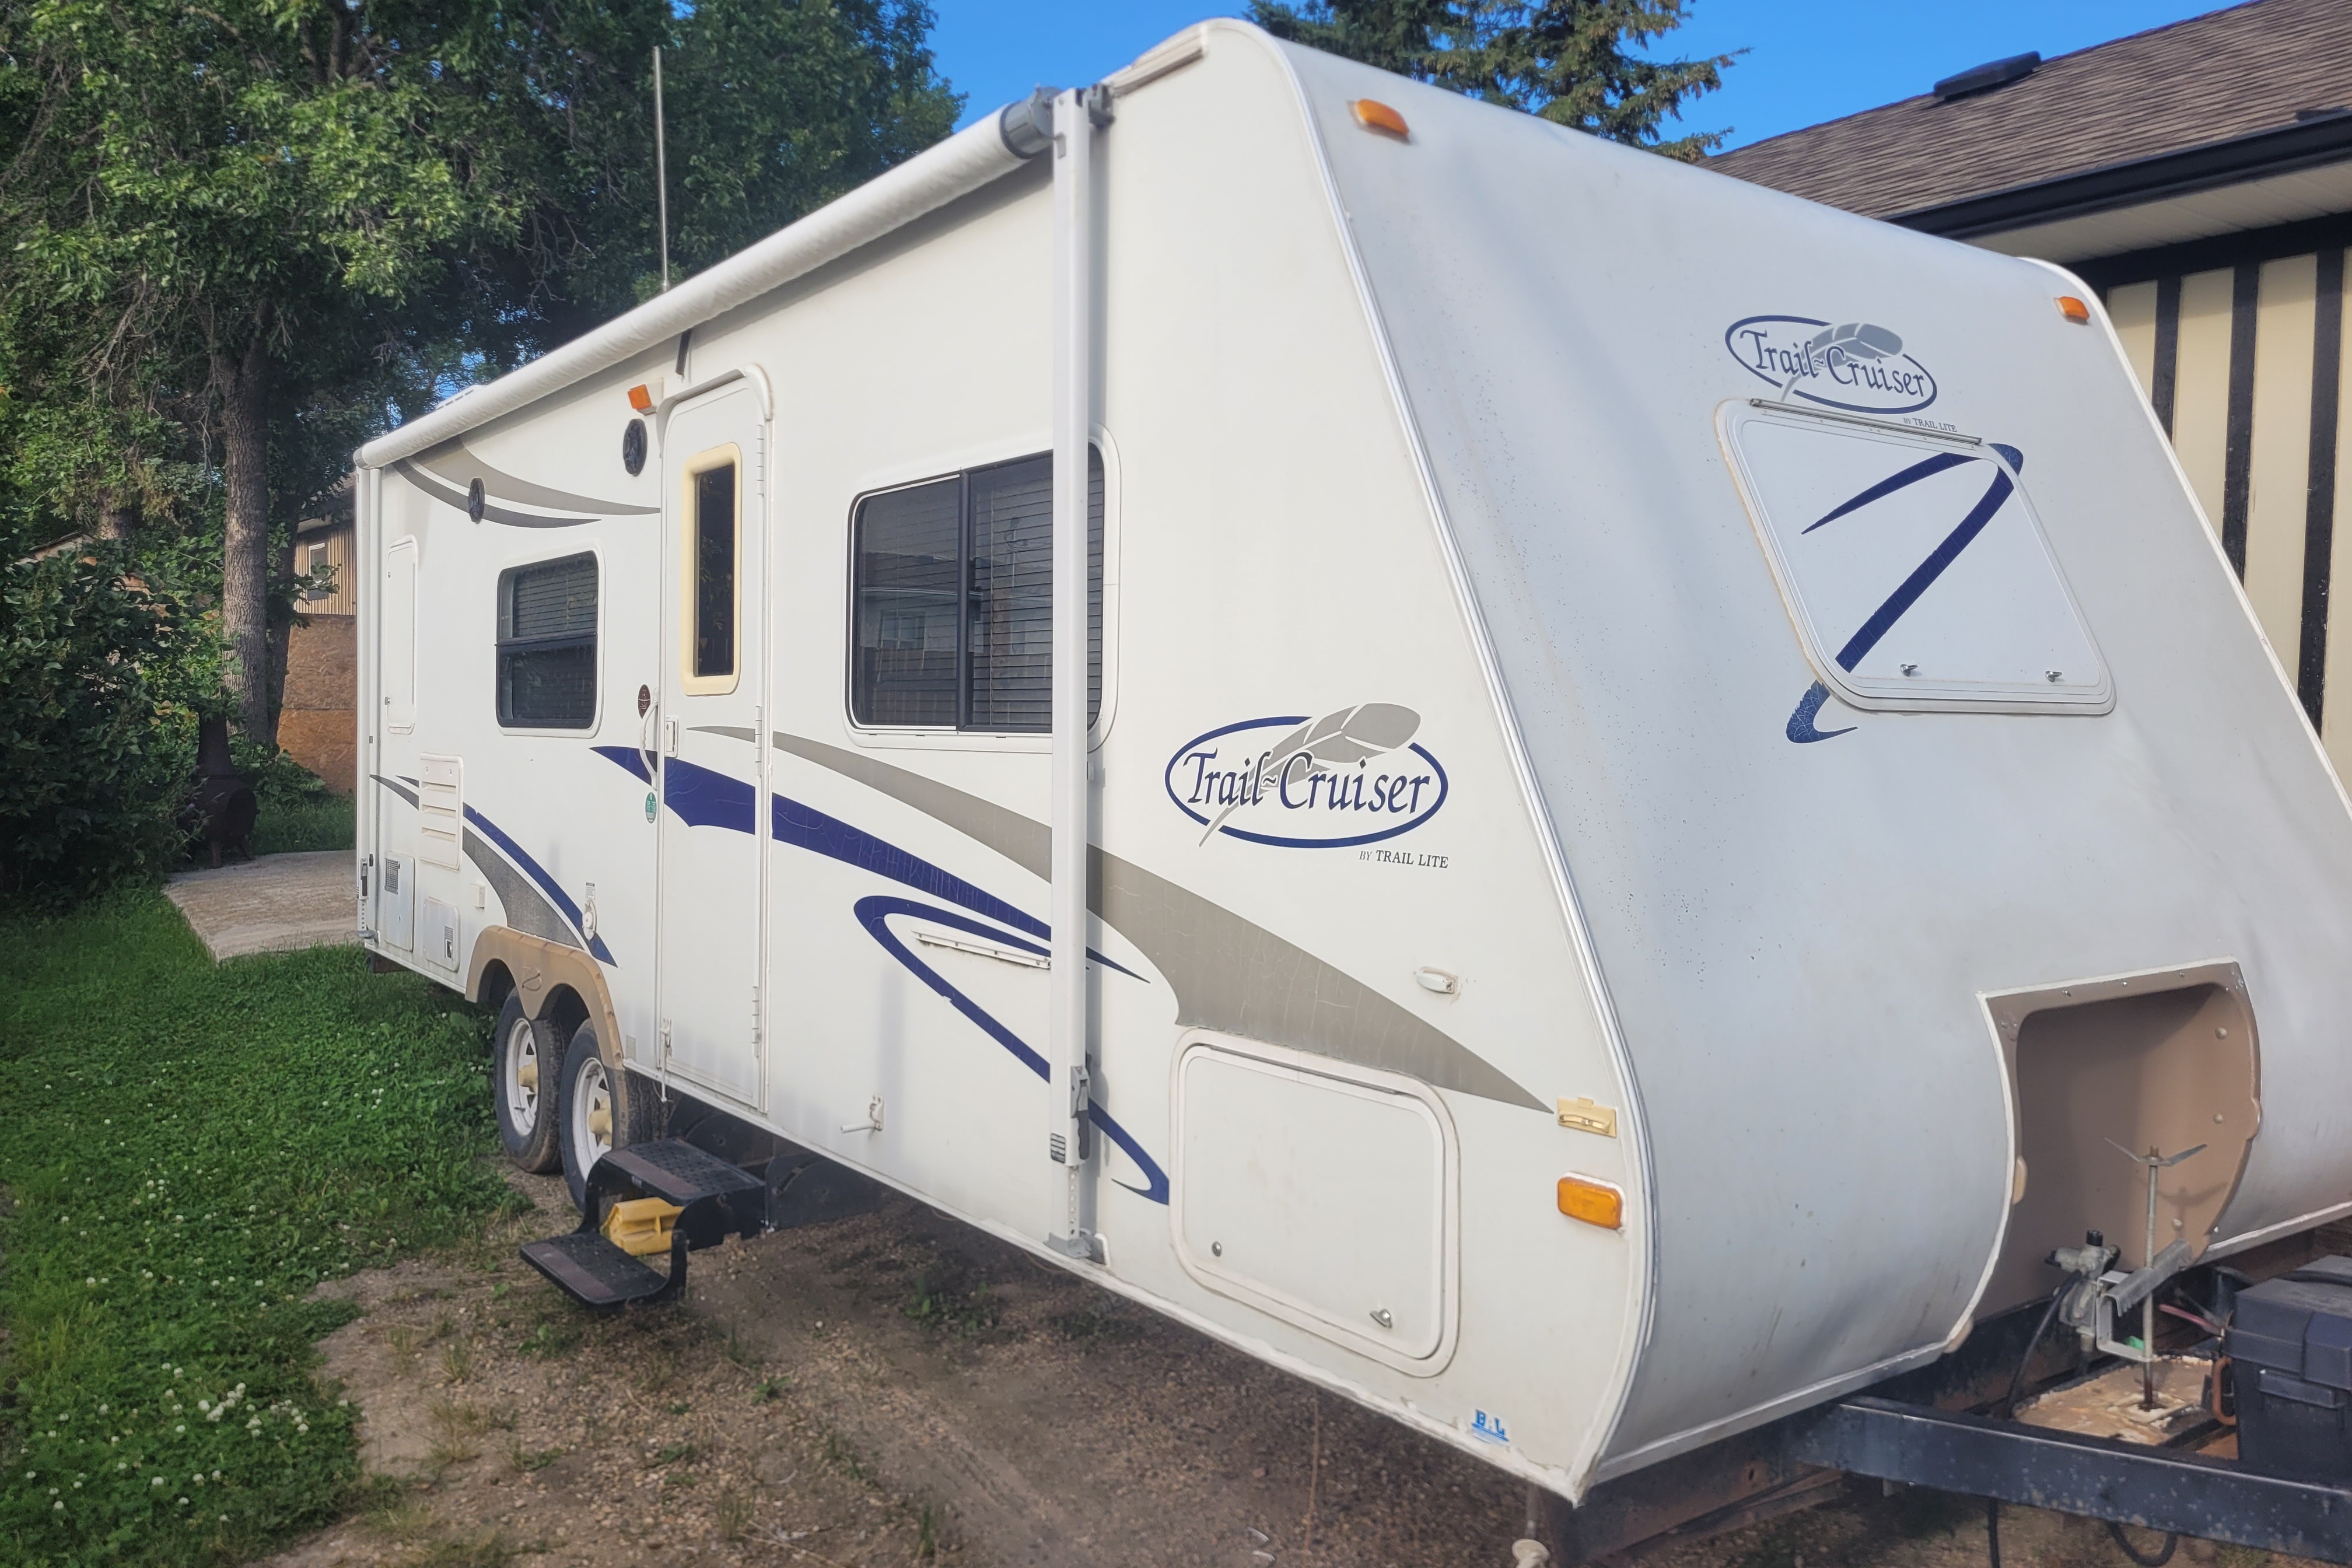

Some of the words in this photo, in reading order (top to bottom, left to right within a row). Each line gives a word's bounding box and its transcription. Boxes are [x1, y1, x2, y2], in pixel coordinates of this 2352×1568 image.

[1913, 418, 1937, 429] TRAIL
[1938, 422, 1957, 432] LITE
[1359, 850, 1372, 860] BY
[1376, 850, 1414, 864] TRAIL
[1418, 854, 1448, 869] LITE
